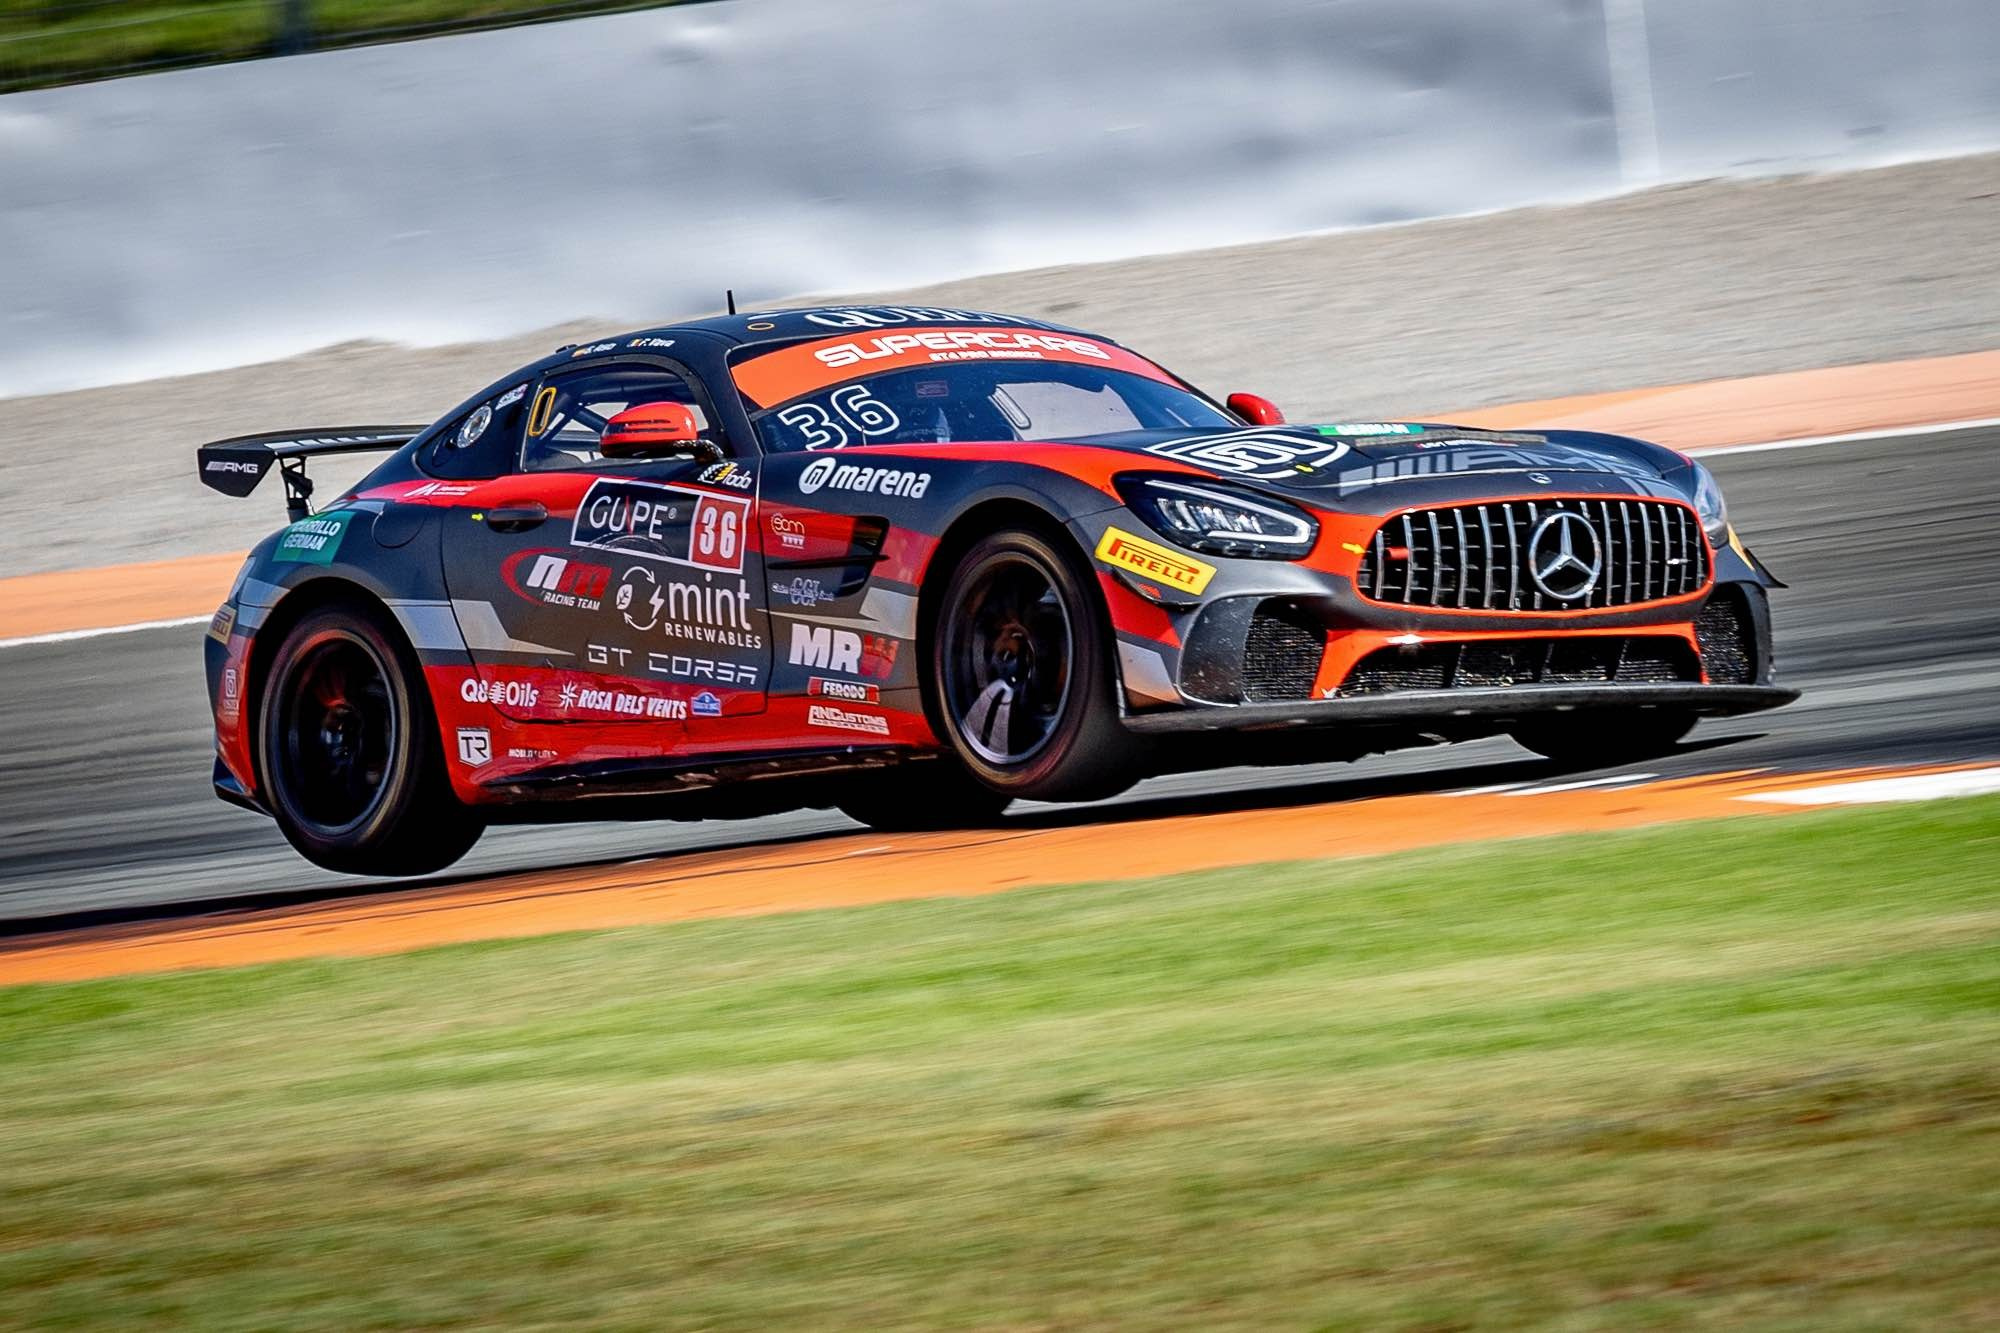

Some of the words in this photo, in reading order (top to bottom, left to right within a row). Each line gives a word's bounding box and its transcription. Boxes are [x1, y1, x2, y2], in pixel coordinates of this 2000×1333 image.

[814, 331, 1112, 367] SUPERCARS
[777, 385, 900, 452] 36
[828, 465, 932, 499] marena
[699, 506, 738, 559] 36
[1107, 537, 1200, 585] PIRELLI
[543, 592, 576, 607] RACING
[577, 598, 601, 611] TEAM
[668, 572, 752, 631] mint
[664, 622, 763, 650] RENEWABLES
[587, 644, 633, 668] GT
[648, 652, 759, 686] CORSA
[461, 678, 489, 703] Q8
[506, 681, 540, 708] Oils
[577, 689, 613, 712] ROSA
[614, 693, 647, 716] DELS
[646, 697, 688, 720] VENTS
[823, 681, 866, 700] FERODO
[460, 736, 488, 759] TR
